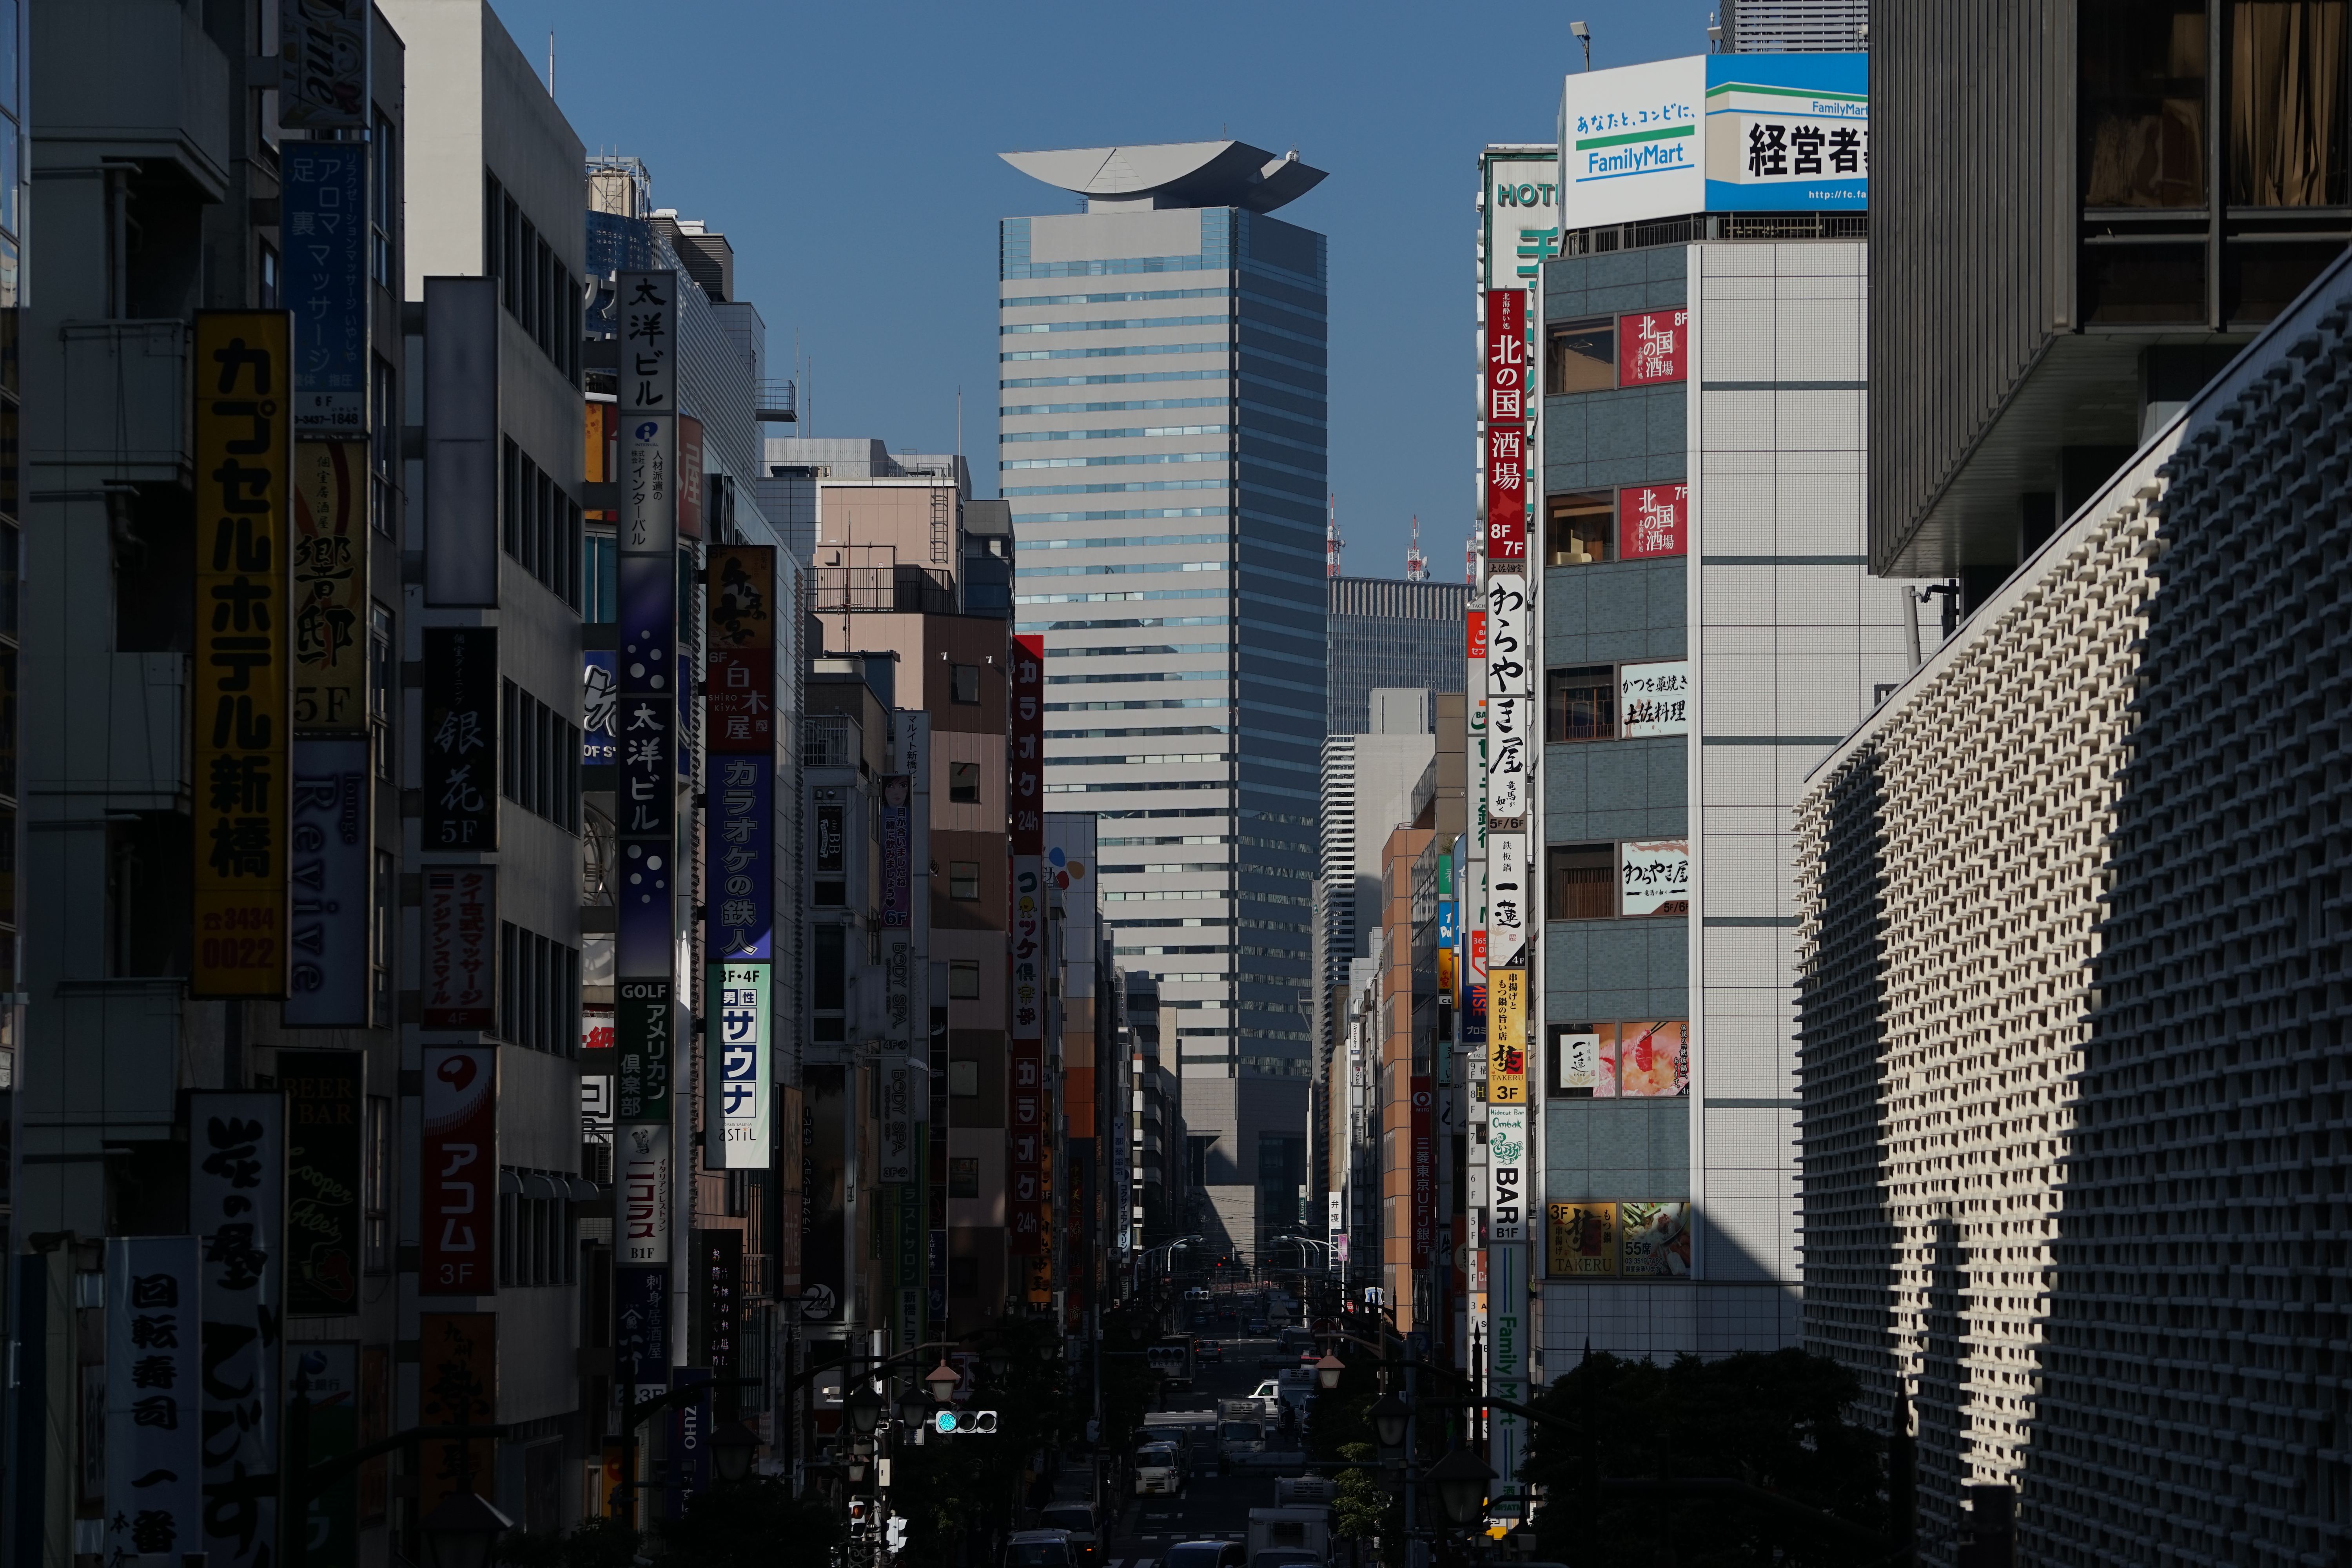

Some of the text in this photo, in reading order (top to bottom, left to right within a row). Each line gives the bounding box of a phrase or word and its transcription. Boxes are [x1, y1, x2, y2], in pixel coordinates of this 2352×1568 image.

[1588, 142, 1684, 174] FamilyMart
[1748, 122, 1868, 177] 経営者
[292, 158, 315, 235] 足裏
[318, 159, 341, 234] アロマ
[308, 245, 330, 372] マッサージ
[1502, 292, 1510, 330] 北海酔い処
[345, 315, 357, 363] いやしや
[629, 278, 666, 407] 太洋ビル
[329, 374, 352, 386] 指圧
[1491, 335, 1522, 490] 北の国酒場
[316, 456, 331, 529] 個室居酒屋
[652, 450, 663, 500] 人材派遣の
[632, 465, 646, 545] インターバル
[1491, 524, 1511, 539] 8F
[1504, 541, 1524, 556] 7F
[710, 549, 727, 558] 6F
[1489, 563, 1524, 573] 土佐個室
[211, 338, 276, 877] カプセルホテル新橋
[453, 633, 465, 704] 個室ダイニング
[709, 652, 728, 662] 6F
[1489, 582, 1524, 775] わらやき屋
[1622, 675, 1688, 694] かつを藁焼き
[294, 687, 350, 722] 5F
[725, 661, 769, 739] 白木屋
[1624, 700, 1686, 725] 土佐料理
[433, 711, 485, 813] 銀花
[604, 746, 616, 758] S
[1018, 660, 1038, 831] カラオケ 24h
[626, 702, 665, 831] 太洋ビル
[441, 820, 478, 843] 5F
[1490, 818, 1524, 829] 5F/6F
[720, 760, 758, 956] カラオケの鉄人
[829, 833, 840, 854] BB
[886, 815, 896, 898] 一緒に飲みましょう
[896, 808, 906, 887] 目が合いましたね
[1503, 841, 1512, 873] 鉄板鍋
[293, 779, 336, 990] Revive
[1623, 859, 1688, 885] わらやき屋
[225, 908, 274, 930] 3434
[884, 909, 907, 926] 6F
[1495, 882, 1521, 929] 一蓮
[203, 938, 274, 969] 0022
[432, 894, 450, 1005] アジアンスマイル
[460, 873, 485, 1006] タイ古式マッサージ
[893, 942, 906, 987] BODY
[1512, 955, 1525, 965] 4F
[621, 985, 666, 998] GOLF
[722, 991, 756, 1005] 男性
[1508, 973, 1518, 1009] 串揚げと
[448, 1013, 468, 1025] 4F
[1498, 980, 1508, 1041] もつ鍋の旨い店
[647, 1004, 666, 1100] アメリカン
[723, 1009, 755, 1116] サウナ
[884, 1040, 897, 1049] 4F
[1572, 1041, 1590, 1073] 一蓮
[283, 1078, 354, 1098] BEER
[621, 1054, 641, 1116] 倶楽部
[893, 1070, 906, 1114] BODY
[1497, 1086, 1518, 1100] 3F
[298, 1104, 353, 1124] BAR
[1492, 1117, 1523, 1129] Ombak
[1017, 1061, 1037, 1233] カラオケ 24h
[802, 1107, 811, 1234] リラクゼーション セラピー
[884, 1168, 897, 1178] 3F
[1070, 1164, 1082, 1213] 中華美食
[440, 1143, 477, 1253] アコム
[626, 1160, 656, 1240] ニコラス
[1417, 1137, 1430, 1254] 三菱東京UFJ銀行
[1496, 1168, 1519, 1224] BAR
[1551, 1205, 1568, 1220] 3F
[1331, 1200, 1339, 1230] 弁護
[1496, 1228, 1519, 1238] B1F
[1603, 1209, 1612, 1244] もつ鍋
[631, 1248, 655, 1259] B1F
[1555, 1258, 1612, 1272] TAKERU
[1625, 1241, 1651, 1255] 55席
[440, 1263, 474, 1285] 3F
[646, 1274, 662, 1359] 刺身居酒屋
[1033, 1302, 1047, 1312] 1F
[443, 1321, 474, 1359] 九州
[131, 1274, 178, 1553] 回転寿司 一番
